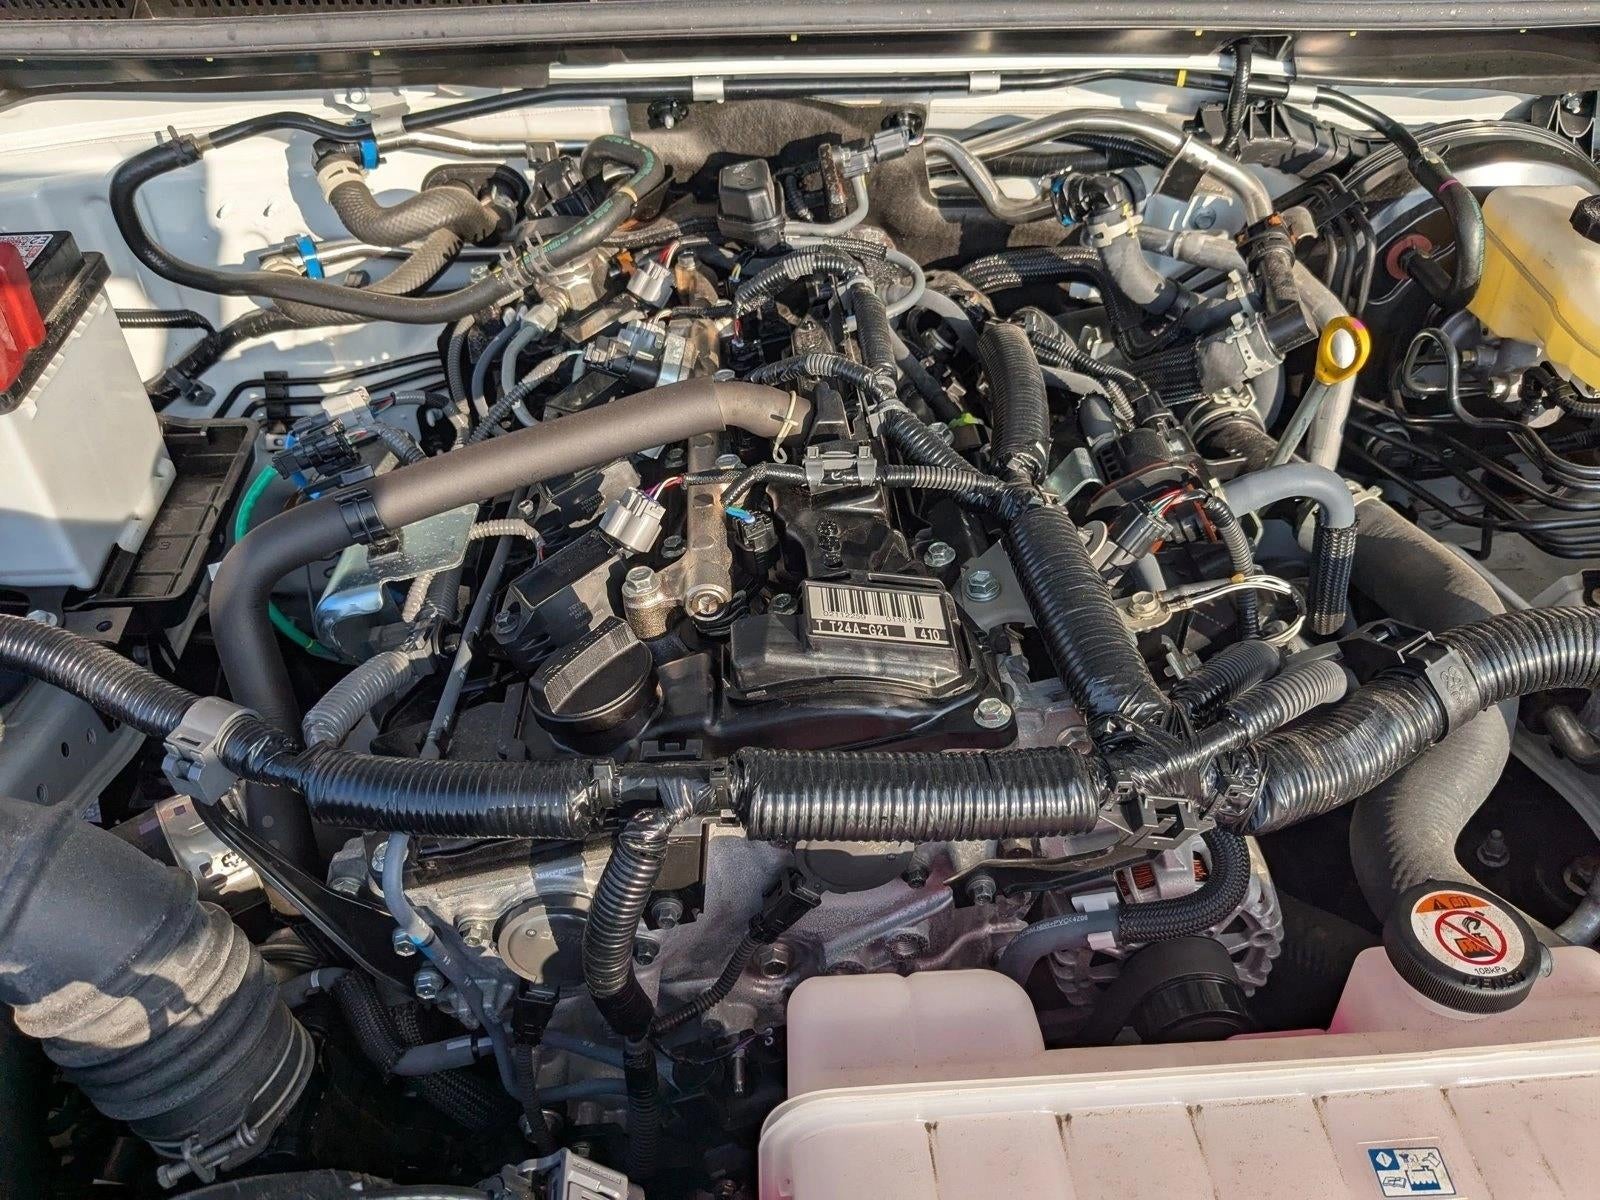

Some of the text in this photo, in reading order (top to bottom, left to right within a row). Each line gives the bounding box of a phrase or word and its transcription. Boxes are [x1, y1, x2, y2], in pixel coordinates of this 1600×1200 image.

[816, 620, 890, 637] T T24A-G21
[920, 628, 940, 641] 410
